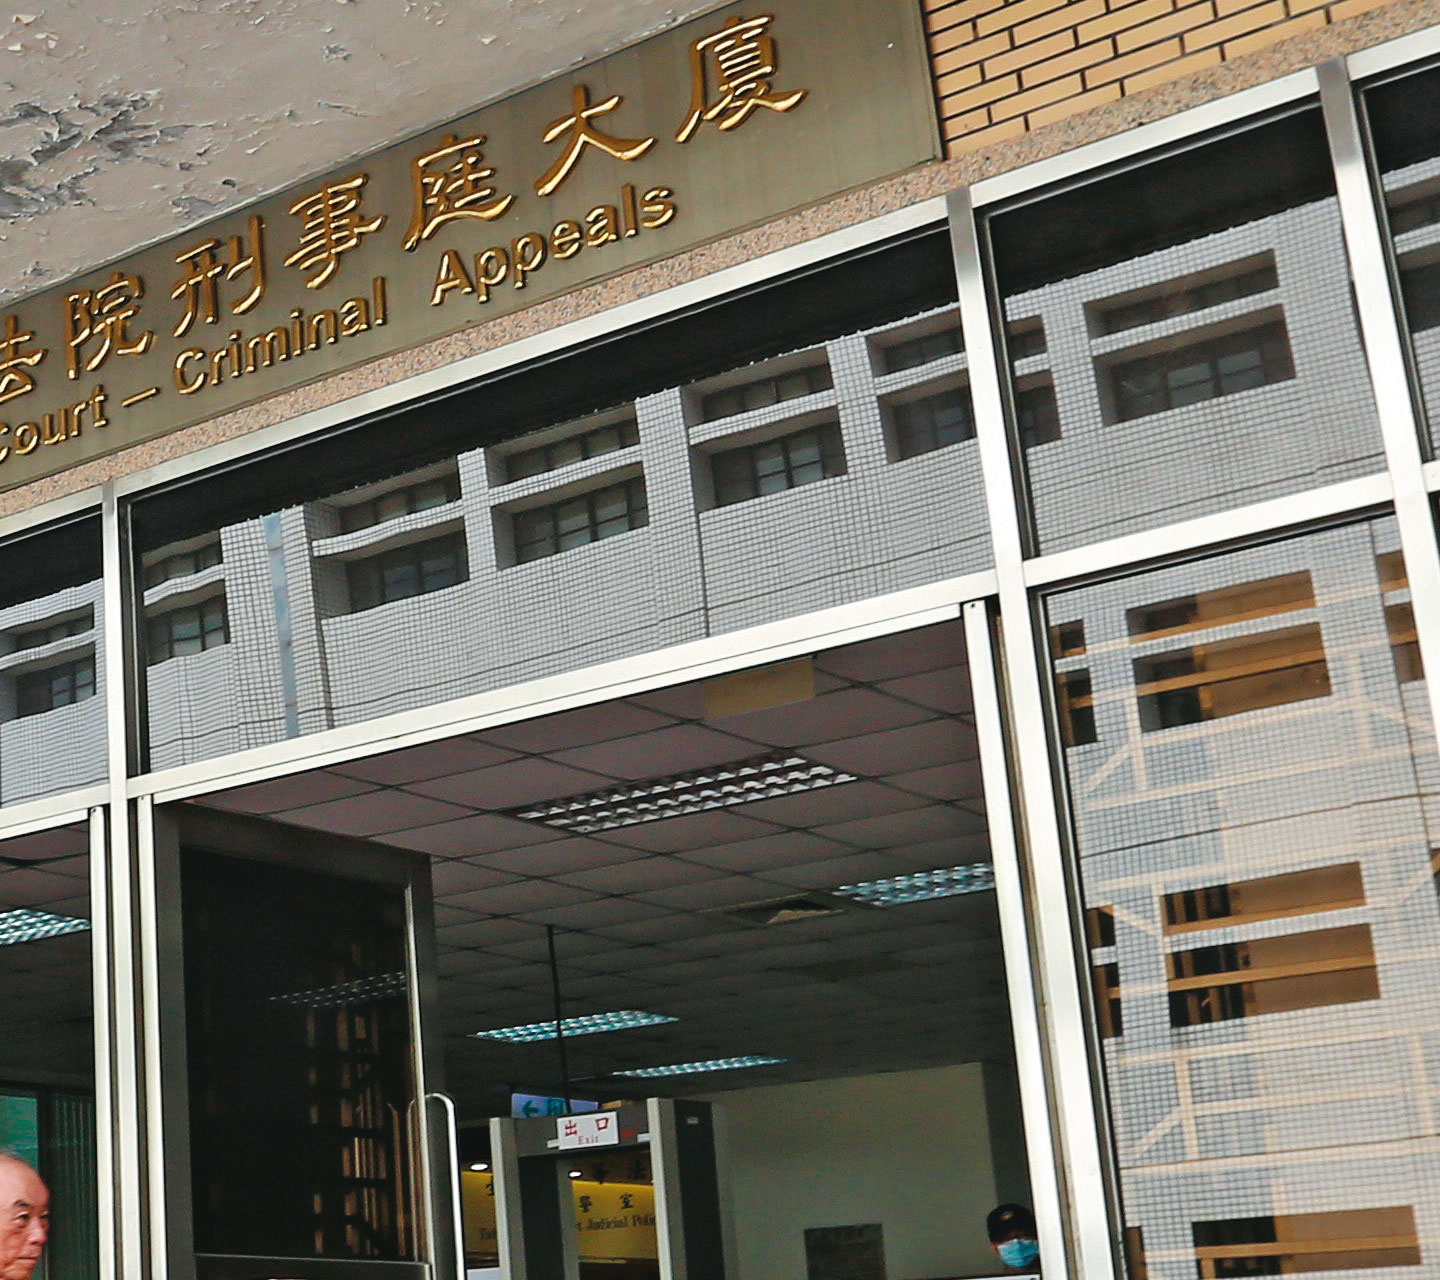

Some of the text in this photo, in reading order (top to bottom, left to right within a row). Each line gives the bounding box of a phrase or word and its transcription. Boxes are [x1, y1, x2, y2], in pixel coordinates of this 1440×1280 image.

[172, 275, 388, 395] Criminal
[430, 182, 678, 307] Appeals
[564, 1117, 610, 1137] 出口
[578, 1134, 599, 1145] Exit
